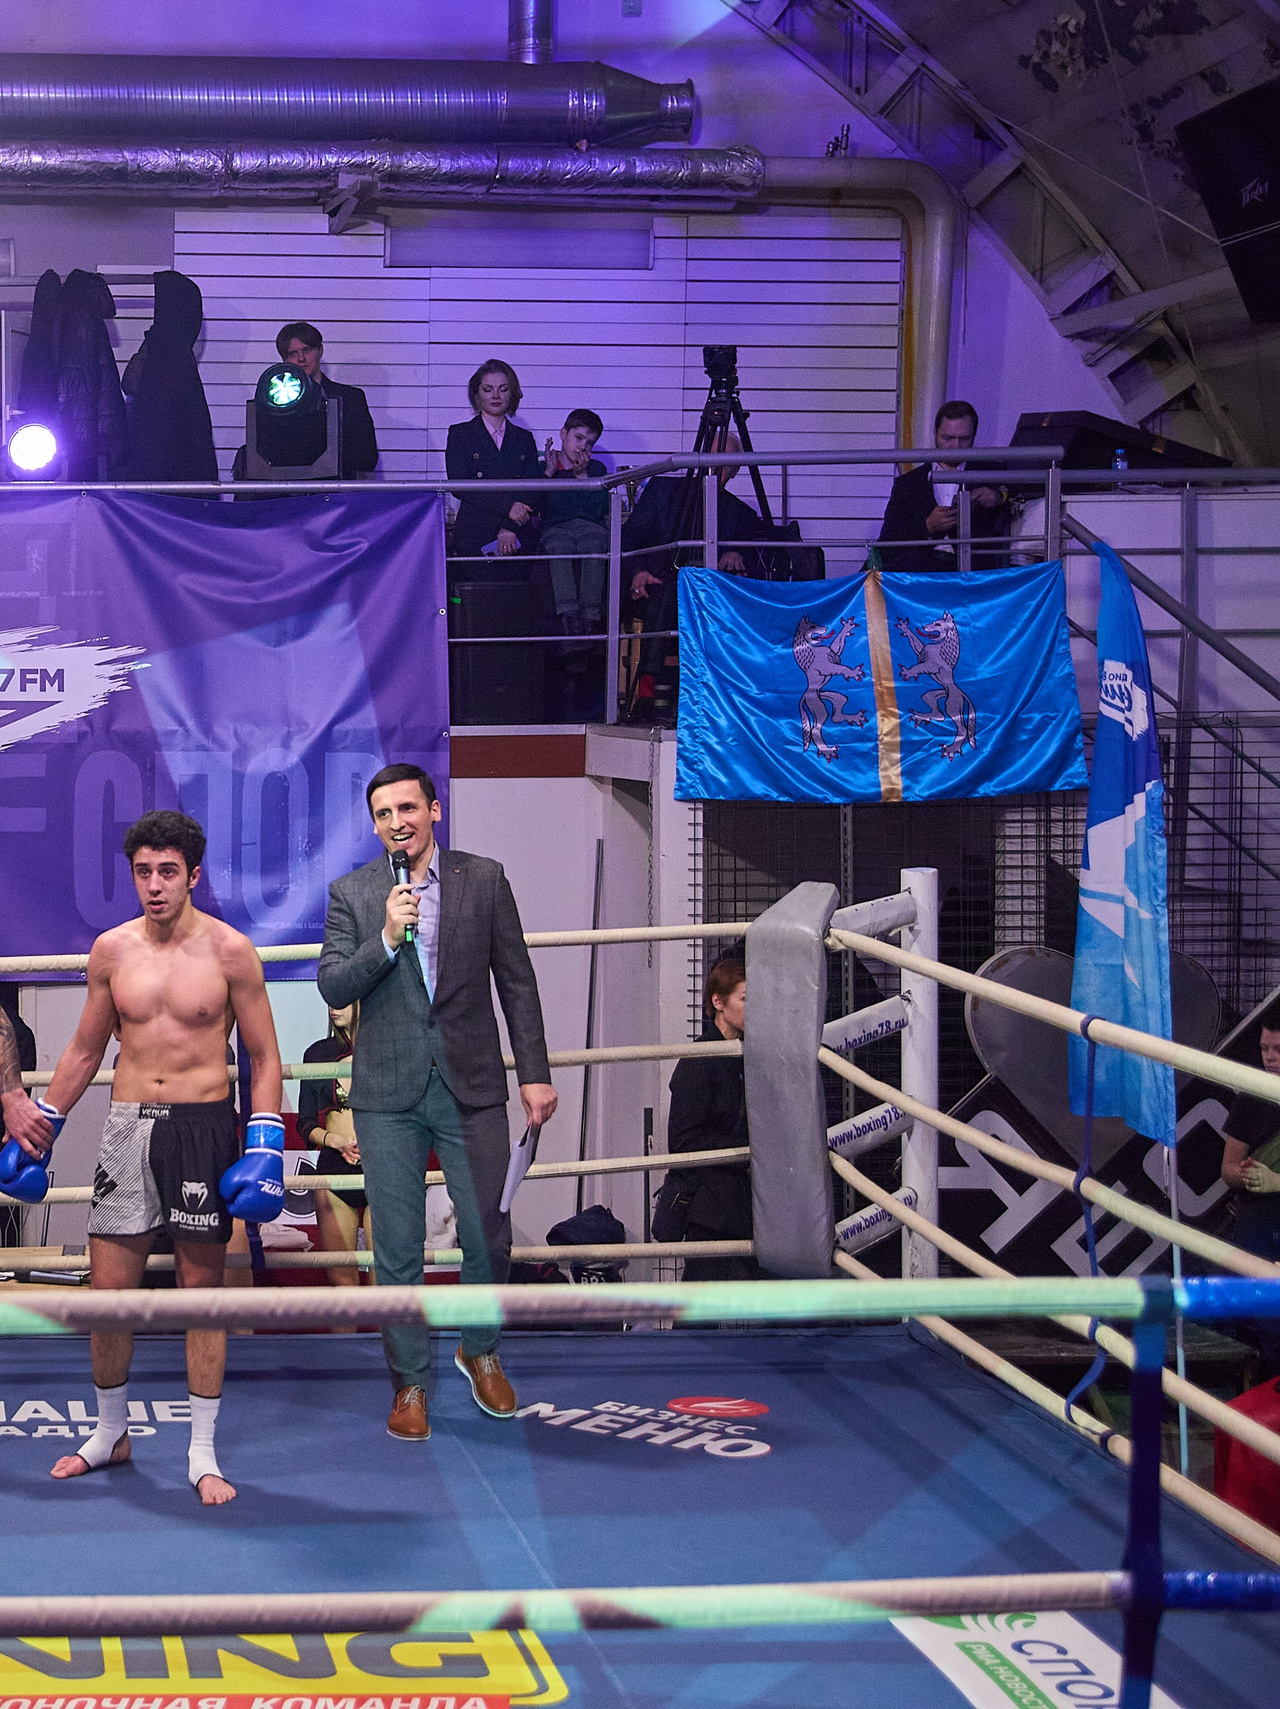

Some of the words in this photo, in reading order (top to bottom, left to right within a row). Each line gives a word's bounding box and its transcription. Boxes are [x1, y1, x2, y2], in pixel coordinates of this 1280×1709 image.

[141, 1108, 170, 1118] VENUM
[169, 1207, 219, 1226] BOXING
[514, 1401, 772, 1458] МЕНЮ
[592, 1400, 757, 1436] БИЗНЕС
